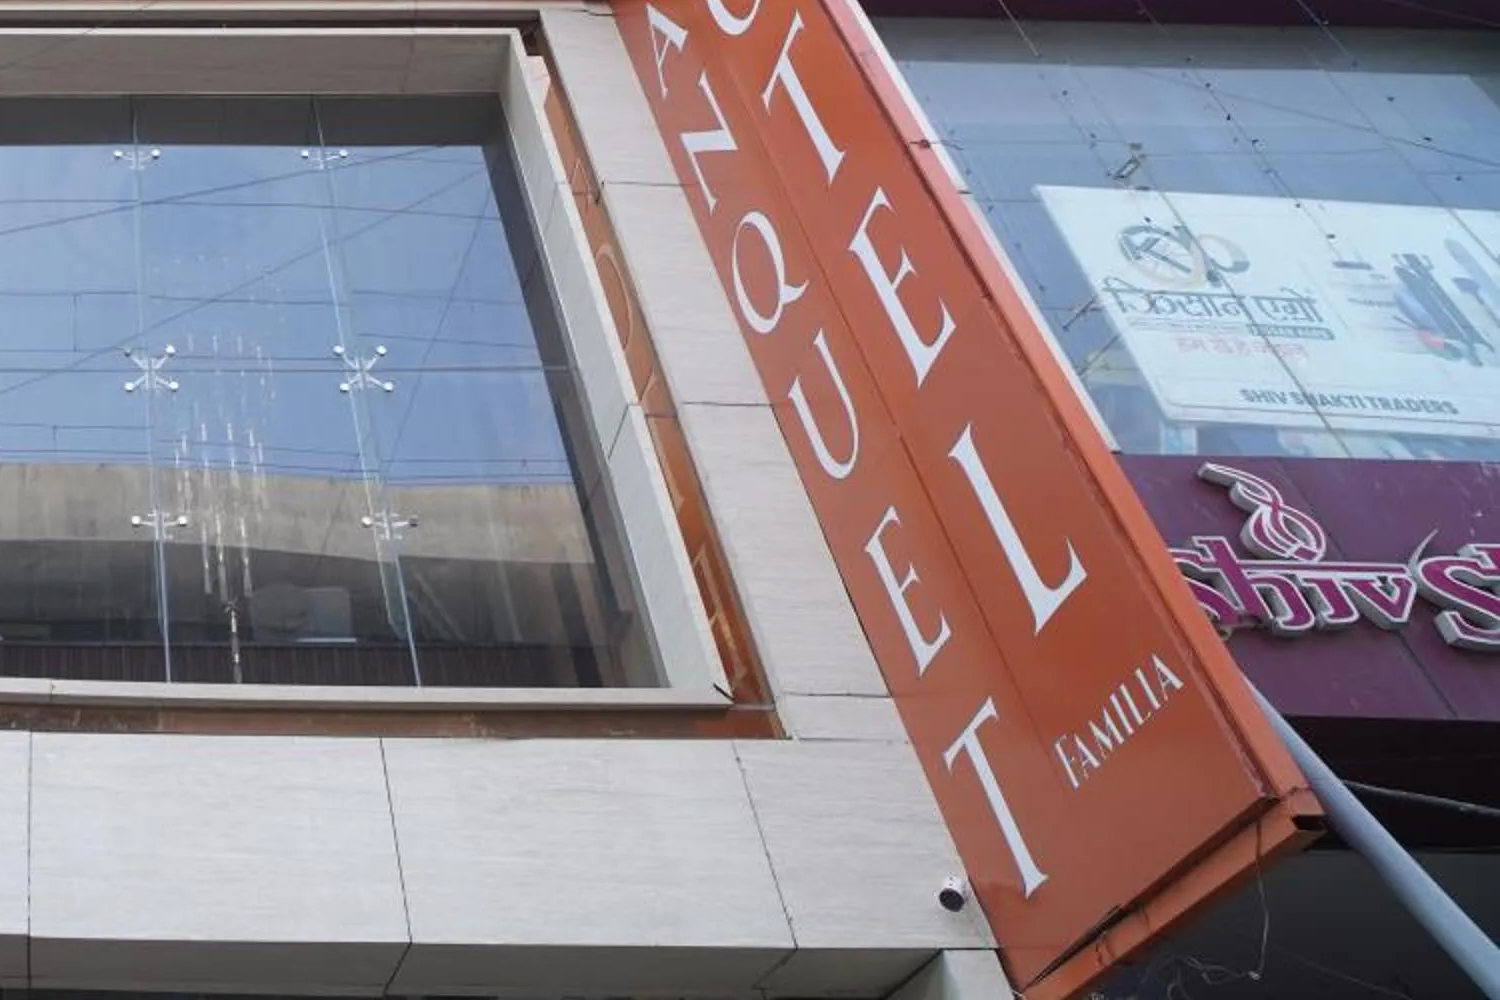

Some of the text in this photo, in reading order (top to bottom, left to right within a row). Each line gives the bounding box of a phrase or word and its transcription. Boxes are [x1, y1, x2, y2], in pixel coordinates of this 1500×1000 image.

[1239, 388, 1460, 415] SHIV SHAKTI TRADERS
[1053, 653, 1185, 789] FAMILIA
